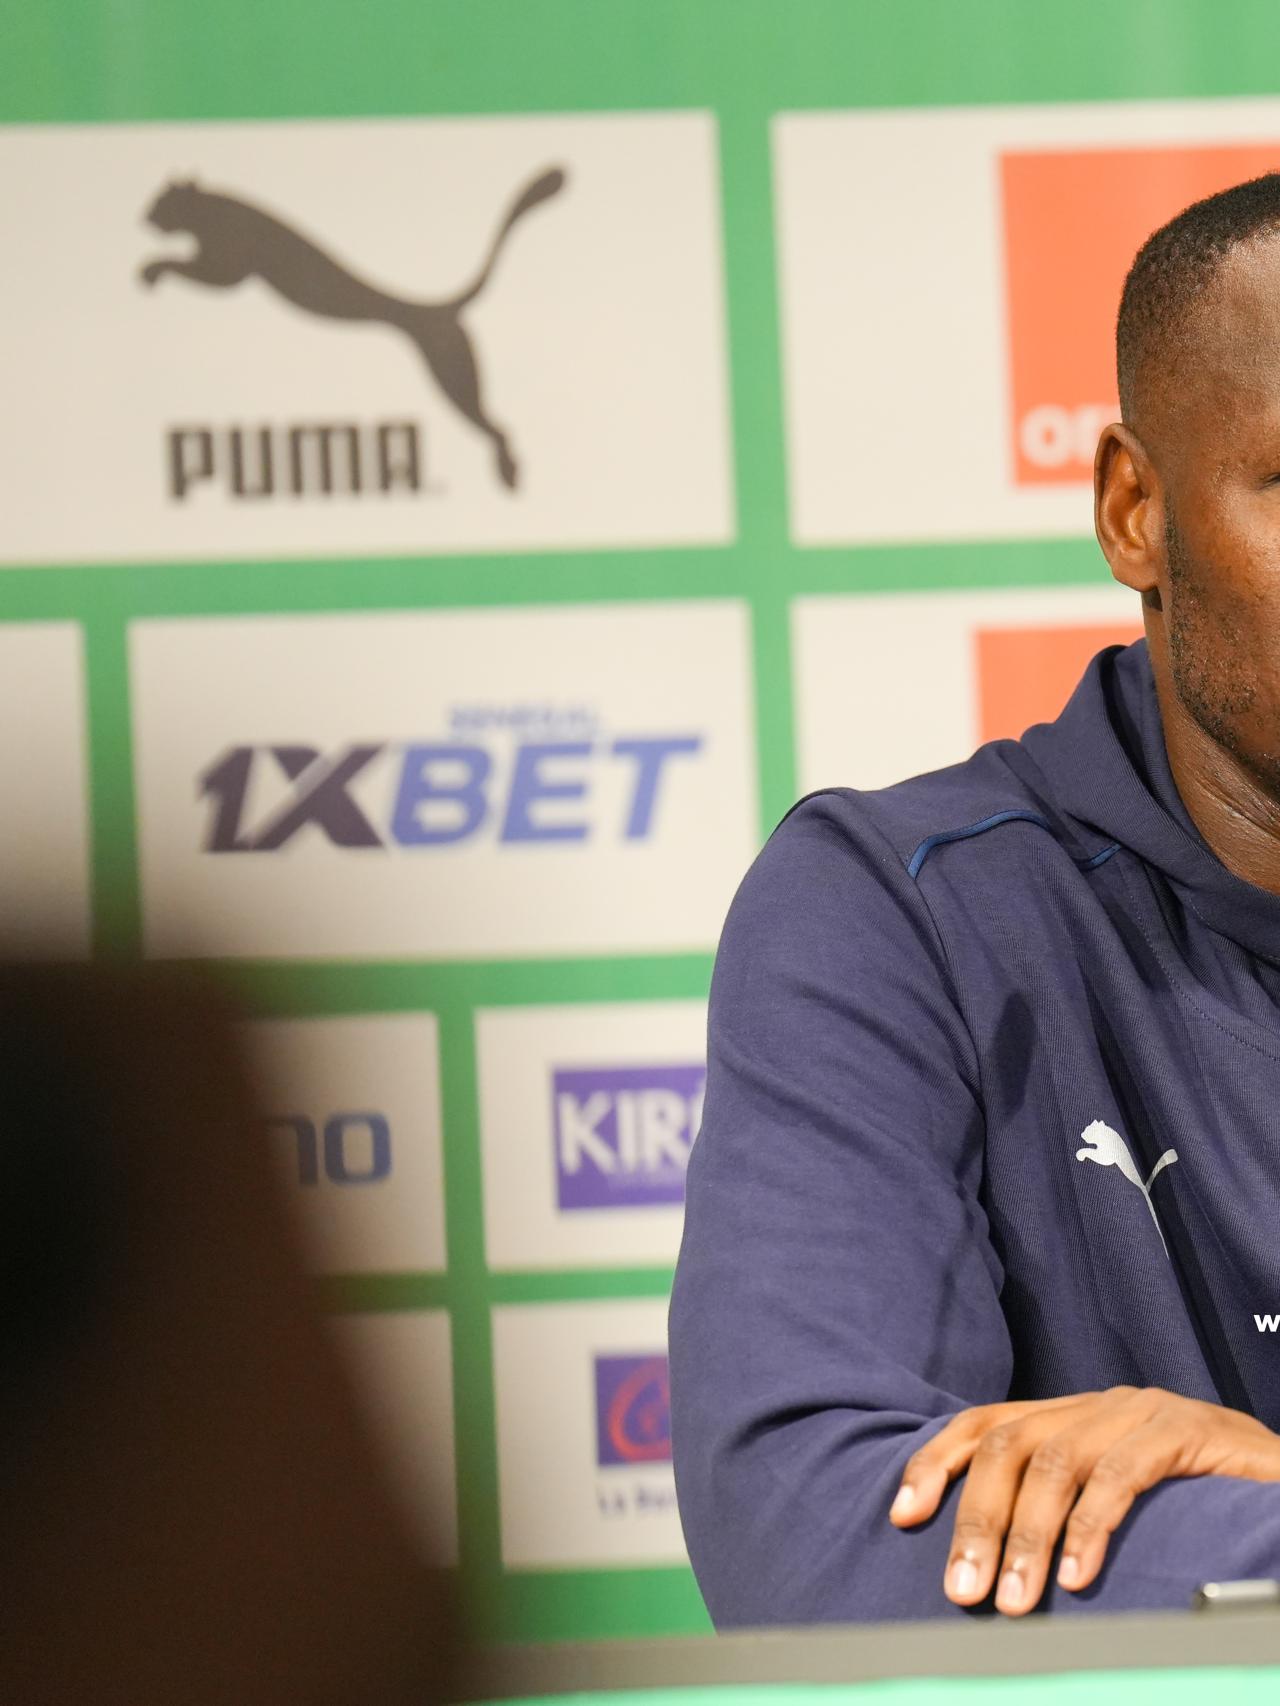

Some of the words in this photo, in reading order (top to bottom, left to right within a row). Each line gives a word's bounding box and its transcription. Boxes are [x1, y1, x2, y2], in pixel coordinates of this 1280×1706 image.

[168, 423, 420, 498] PUMA
[1022, 403, 1122, 467] or
[199, 737, 704, 854] 1XBET
[560, 1086, 705, 1174] KIR
